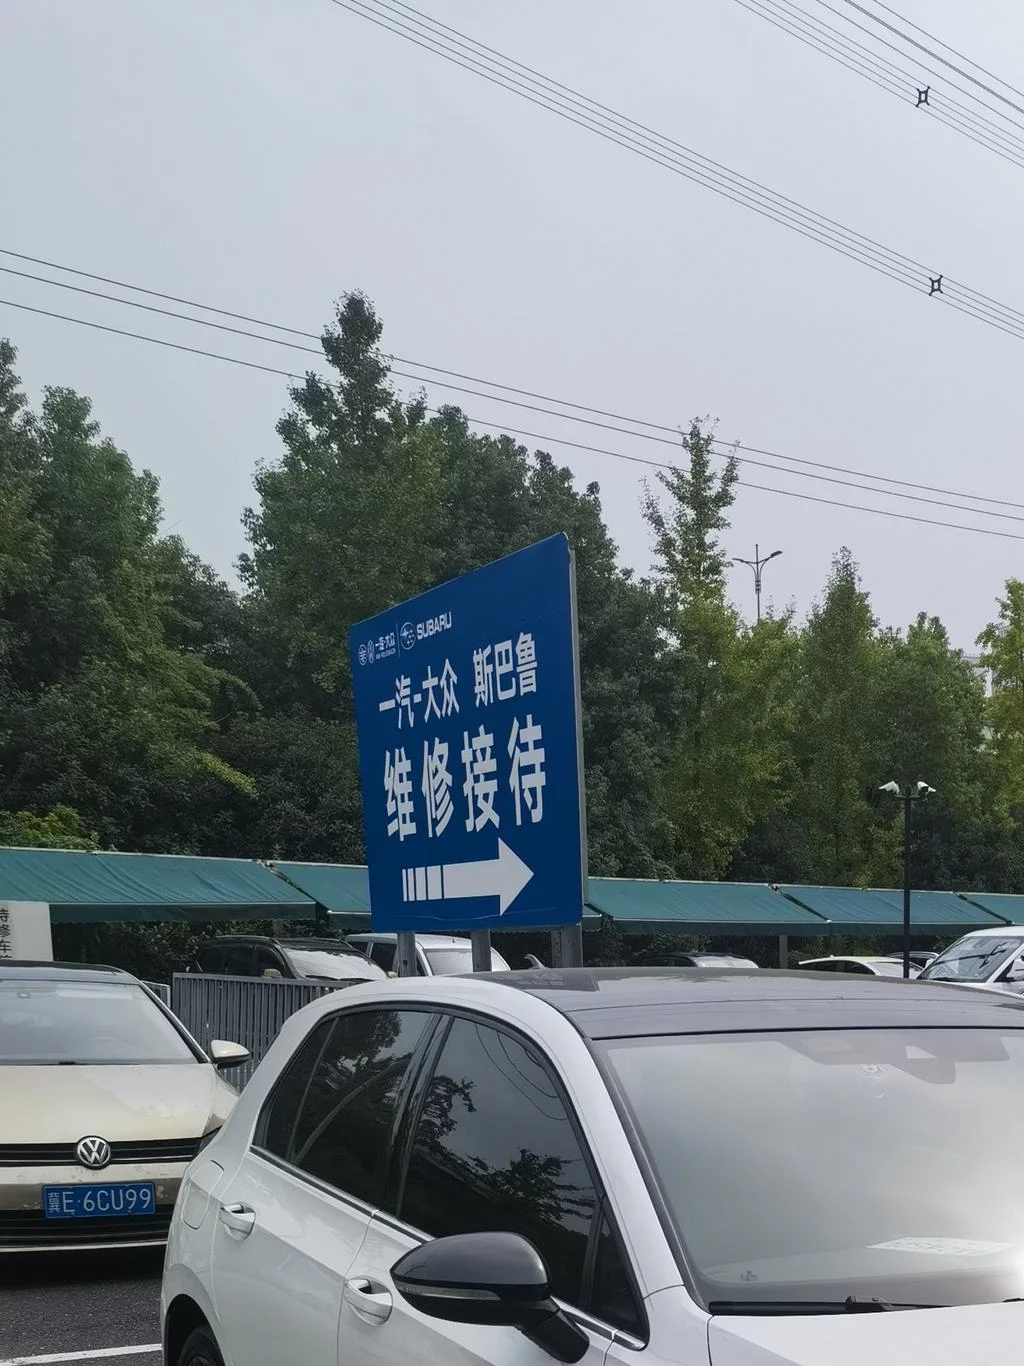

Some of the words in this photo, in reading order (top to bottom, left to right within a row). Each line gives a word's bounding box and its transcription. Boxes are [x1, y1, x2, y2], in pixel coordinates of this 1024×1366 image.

[416, 611, 452, 640] SUBARU
[379, 658, 460, 729] 一汽-大众
[472, 631, 538, 708] 斯巴鲁
[384, 714, 546, 842] 维修接待
